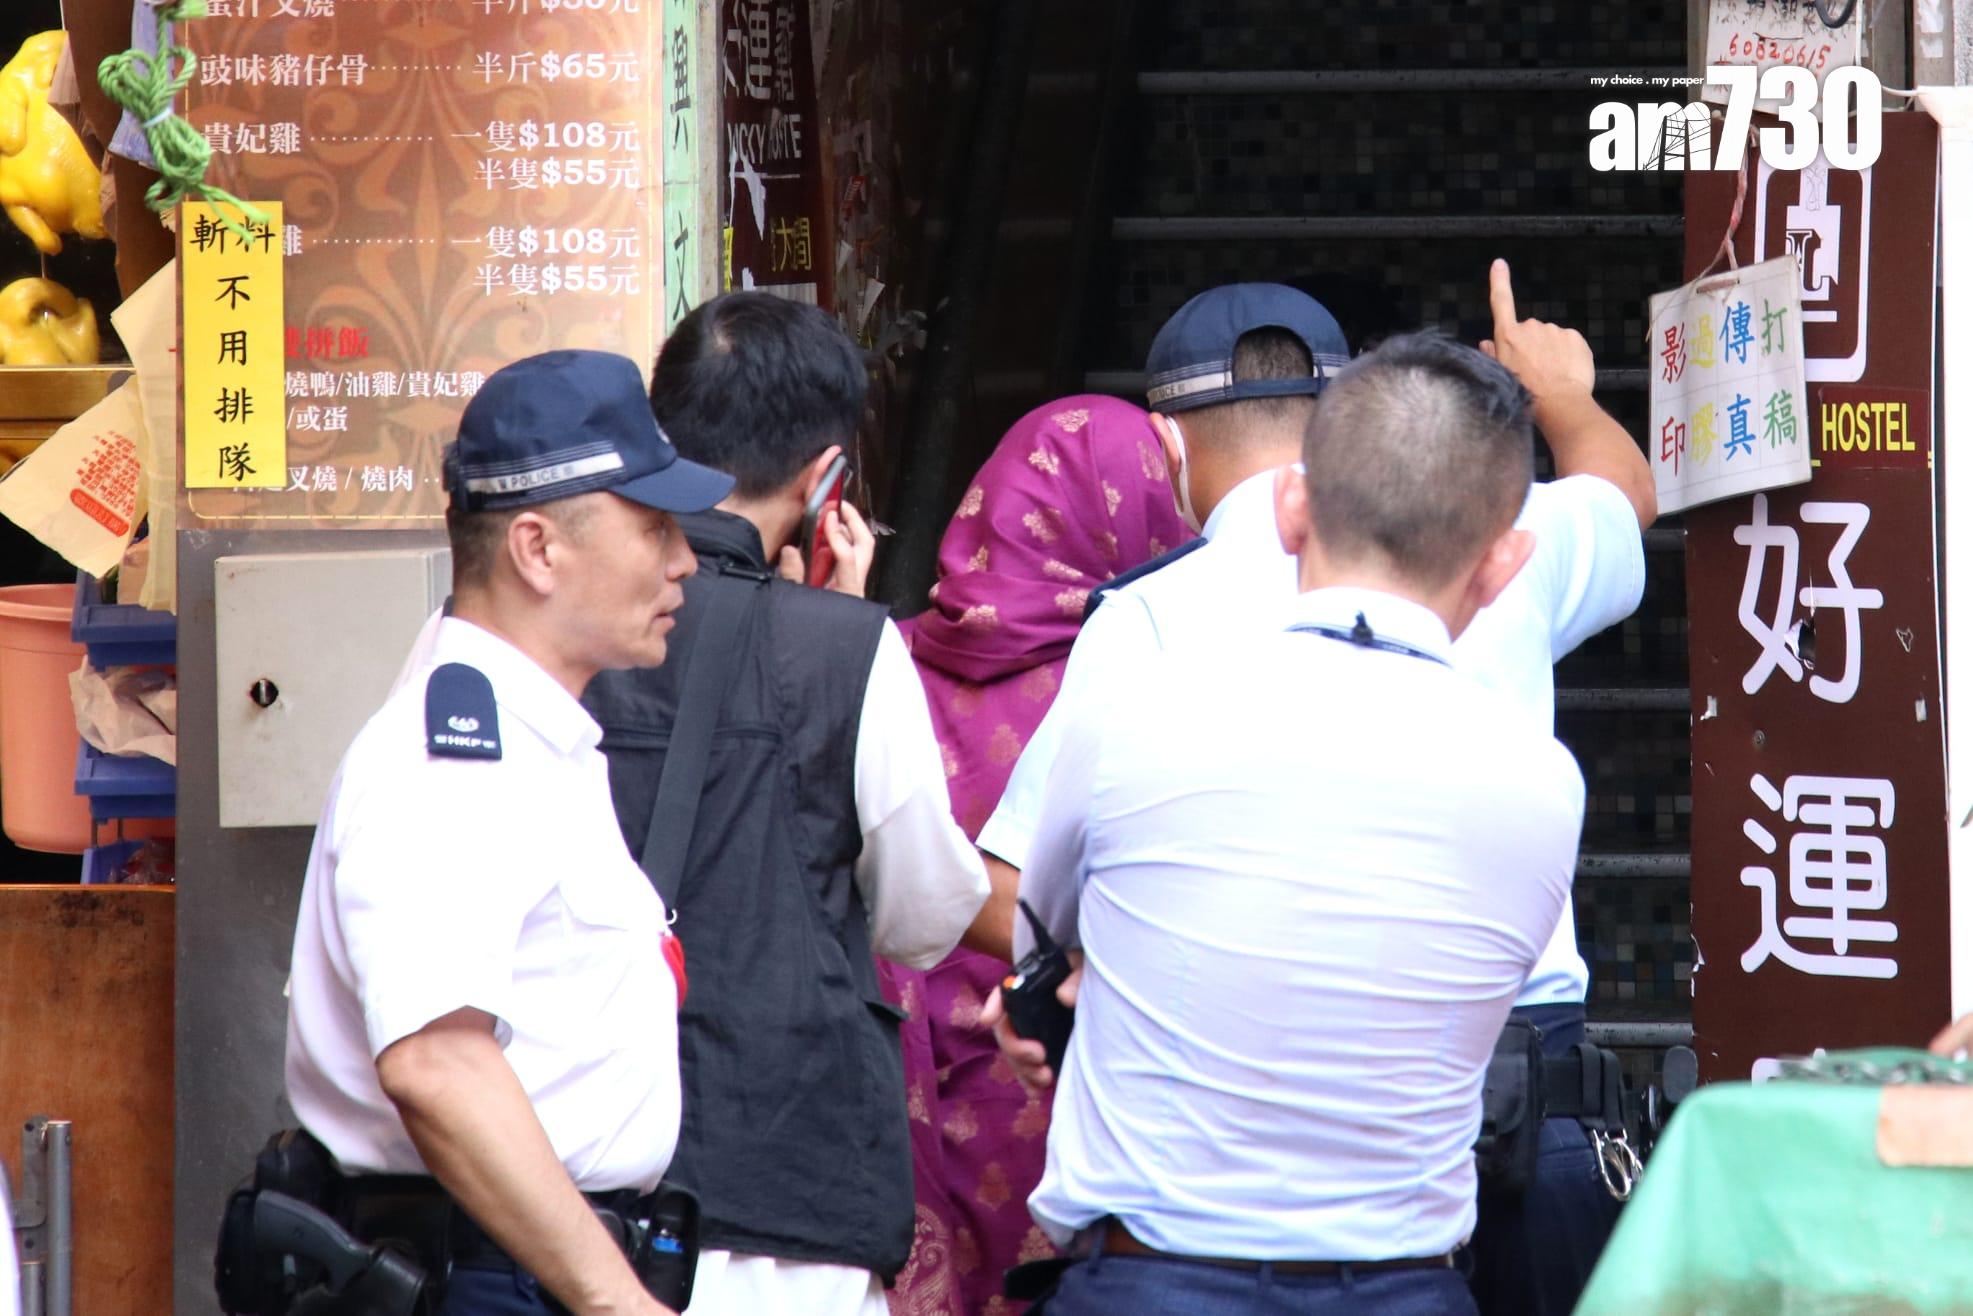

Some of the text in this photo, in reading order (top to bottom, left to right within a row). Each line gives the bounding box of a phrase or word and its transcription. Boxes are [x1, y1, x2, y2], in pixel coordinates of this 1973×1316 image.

[200, 50, 641, 86] 豉味豬仔骨 半斤$65元
[202, 119, 641, 154] 貴妃雞 一隻$108元
[473, 156, 641, 191] 半隻$55元
[189, 213, 276, 255] 斬料
[451, 224, 641, 259] 一隻$108元
[473, 262, 641, 297] 半隻$55元
[212, 275, 258, 483] 不用排隊
[1719, 301, 1757, 461] 傳真
[1761, 299, 1798, 449] 打稿
[1822, 402, 1916, 452] HOSTEL
[361, 465, 414, 493] 燒肉
[511, 469, 559, 489] POLICE
[1733, 492, 1899, 1084] 好運
